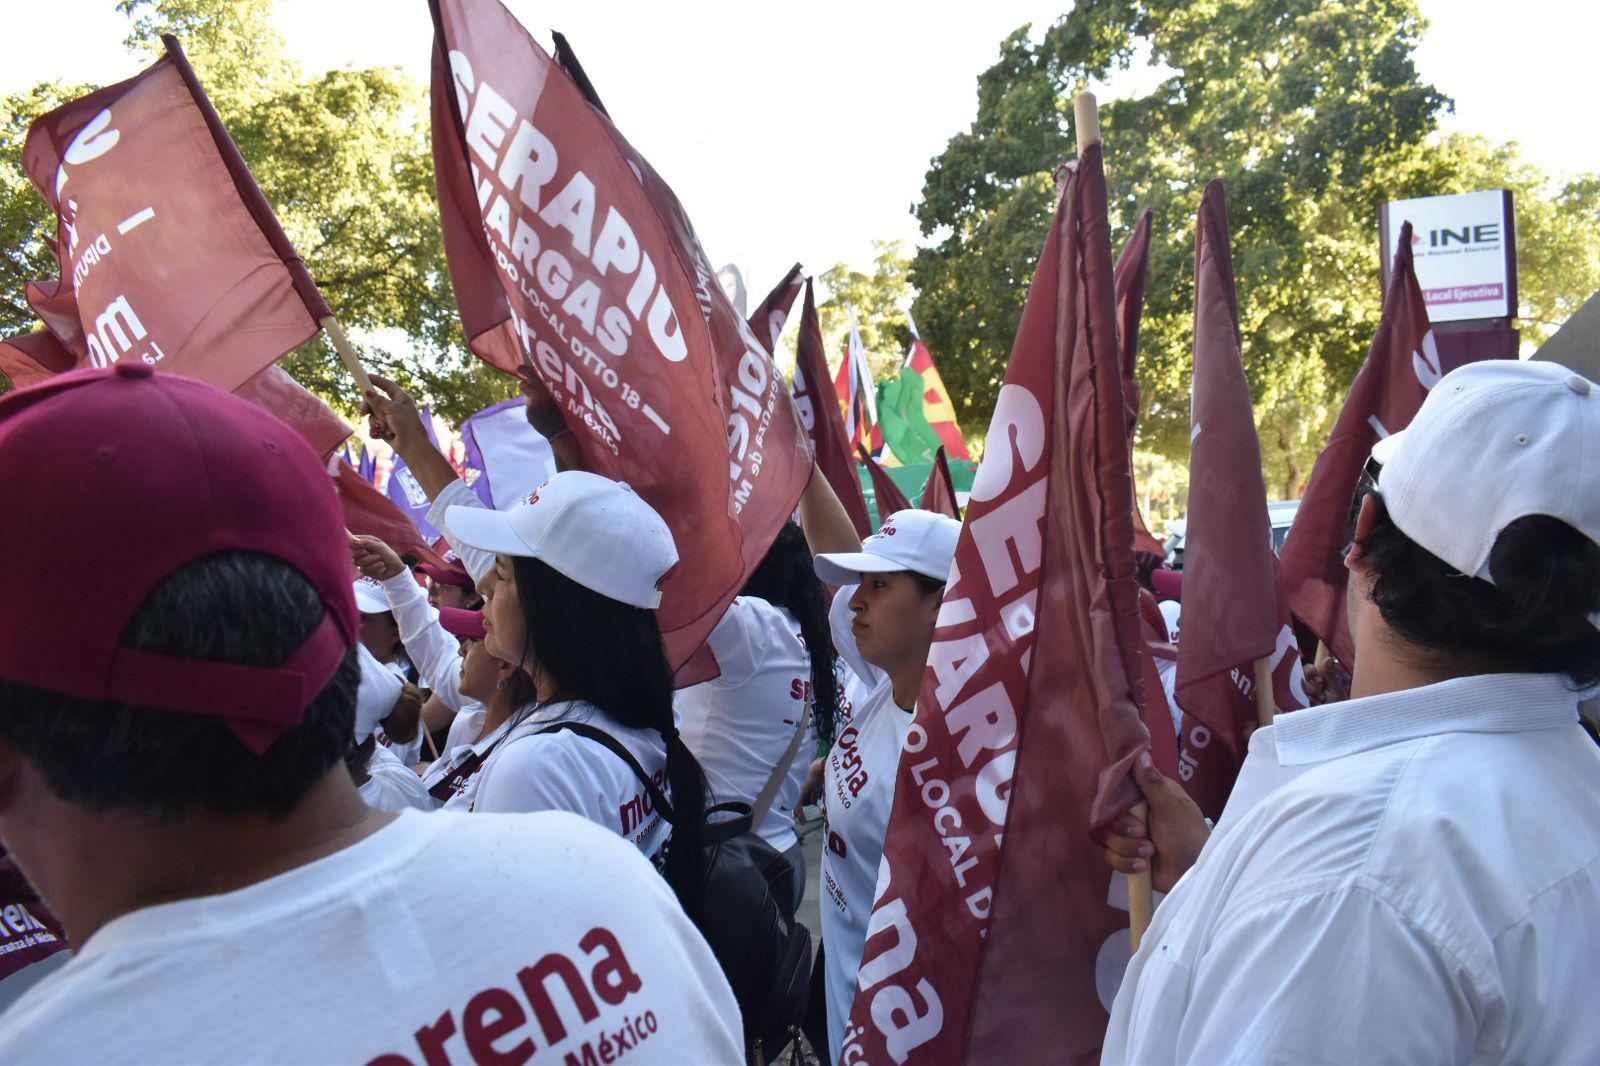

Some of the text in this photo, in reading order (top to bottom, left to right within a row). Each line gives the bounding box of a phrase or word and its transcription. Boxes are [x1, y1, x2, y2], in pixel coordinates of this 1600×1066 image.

[1430, 224, 1499, 247] INE
[521, 278, 568, 343] LOCAL
[571, 336, 618, 388] DTTO
[621, 383, 642, 410] 18
[911, 757, 979, 888] LOCAL
[362, 926, 643, 1066] rena
